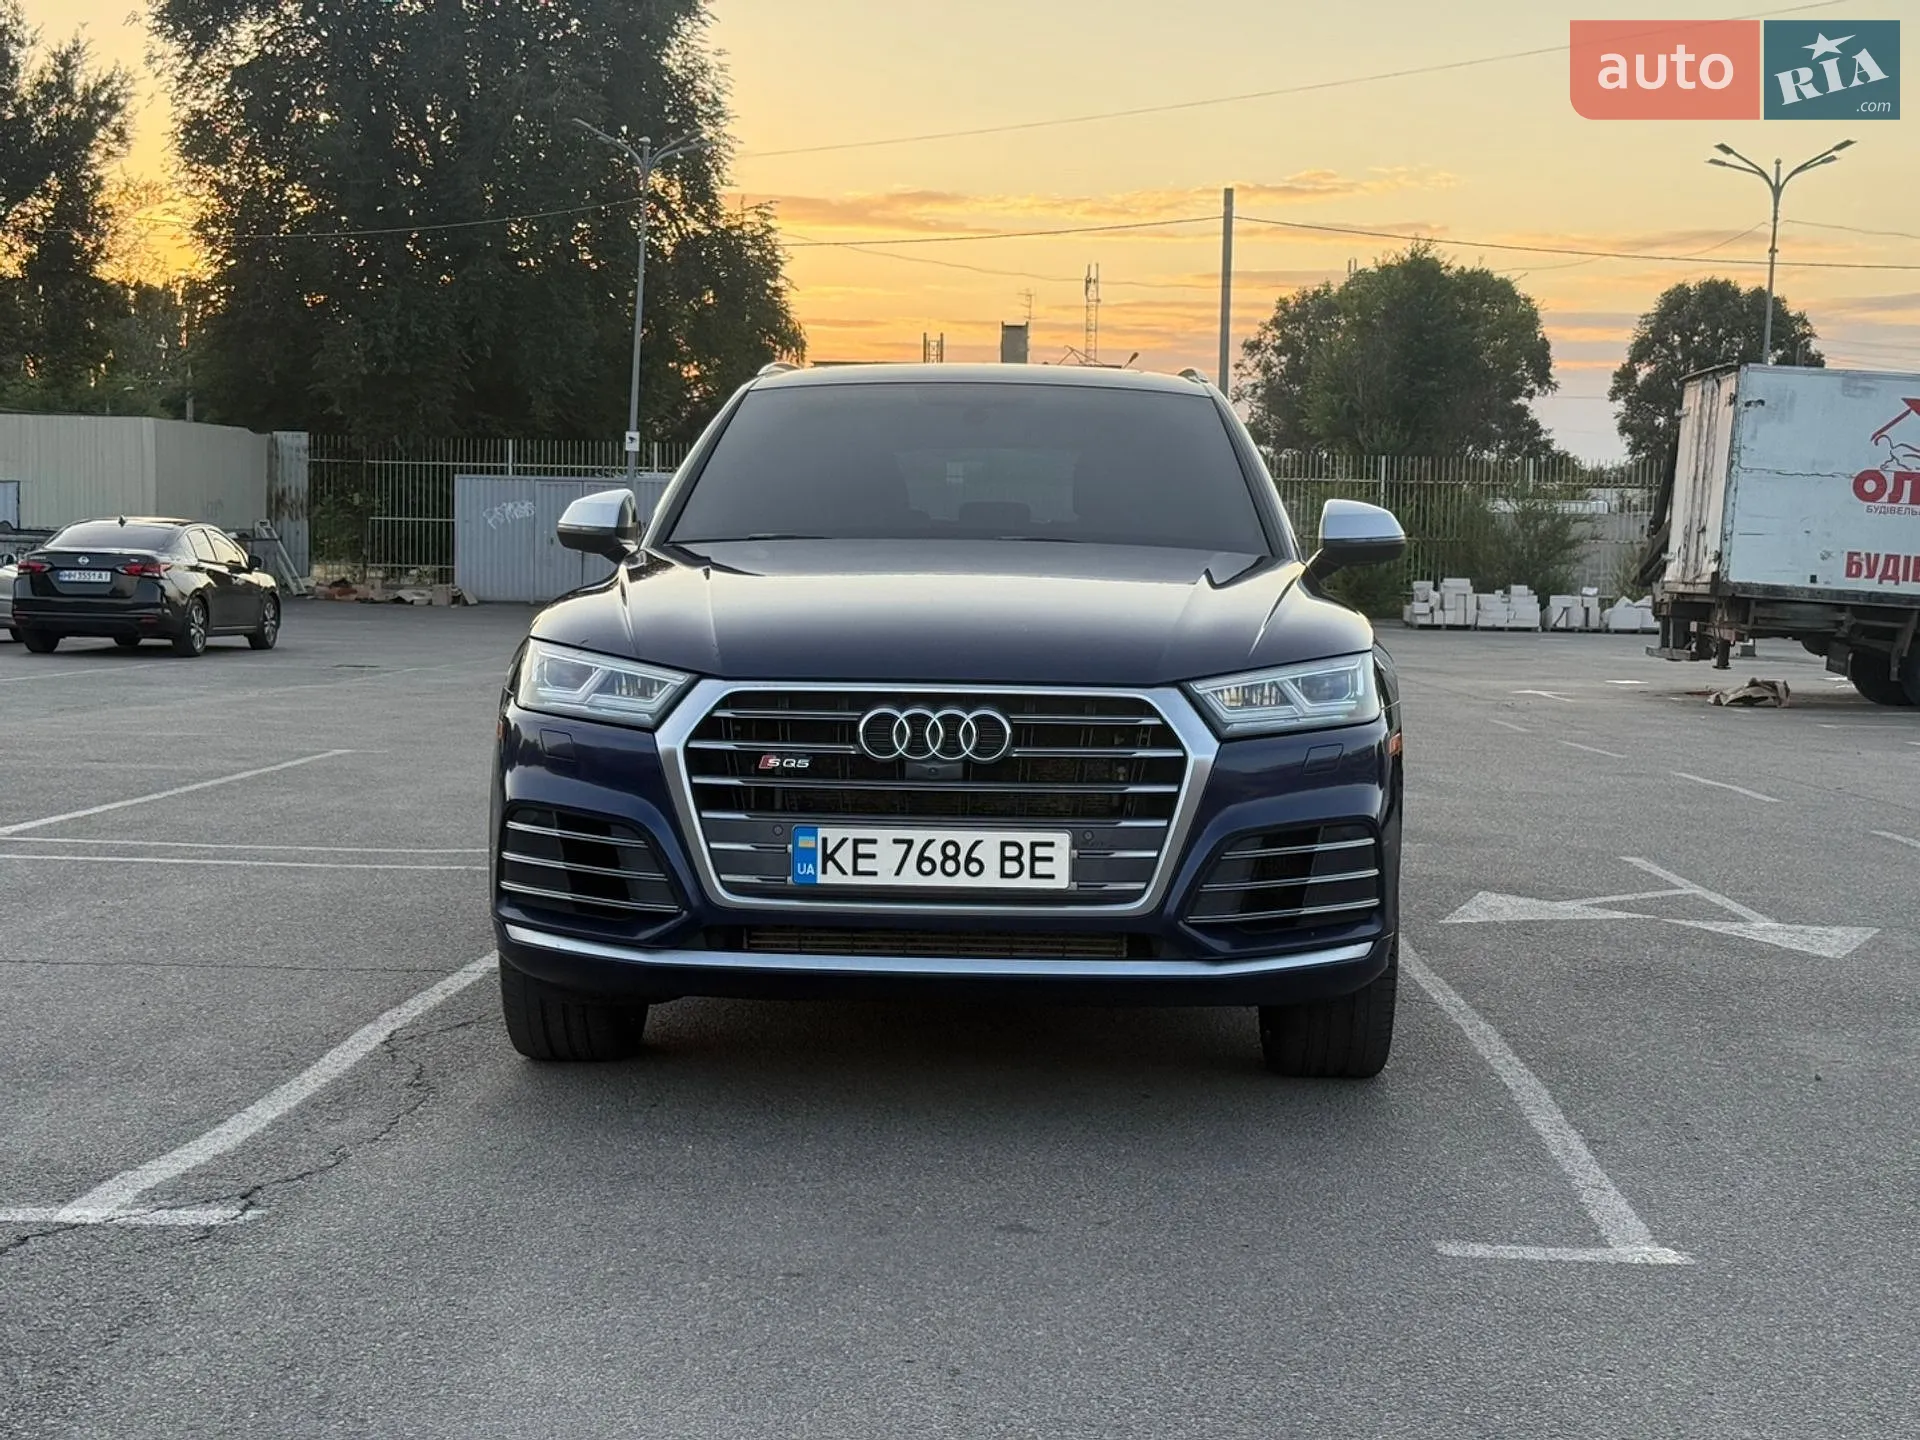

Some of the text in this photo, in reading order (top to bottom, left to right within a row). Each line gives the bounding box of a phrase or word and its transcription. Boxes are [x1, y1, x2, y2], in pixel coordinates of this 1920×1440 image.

[1866, 505, 1920, 516] БУДІВЕЛЬ
[820, 836, 1056, 880] KE 7686 BE
[797, 862, 815, 876] UA
